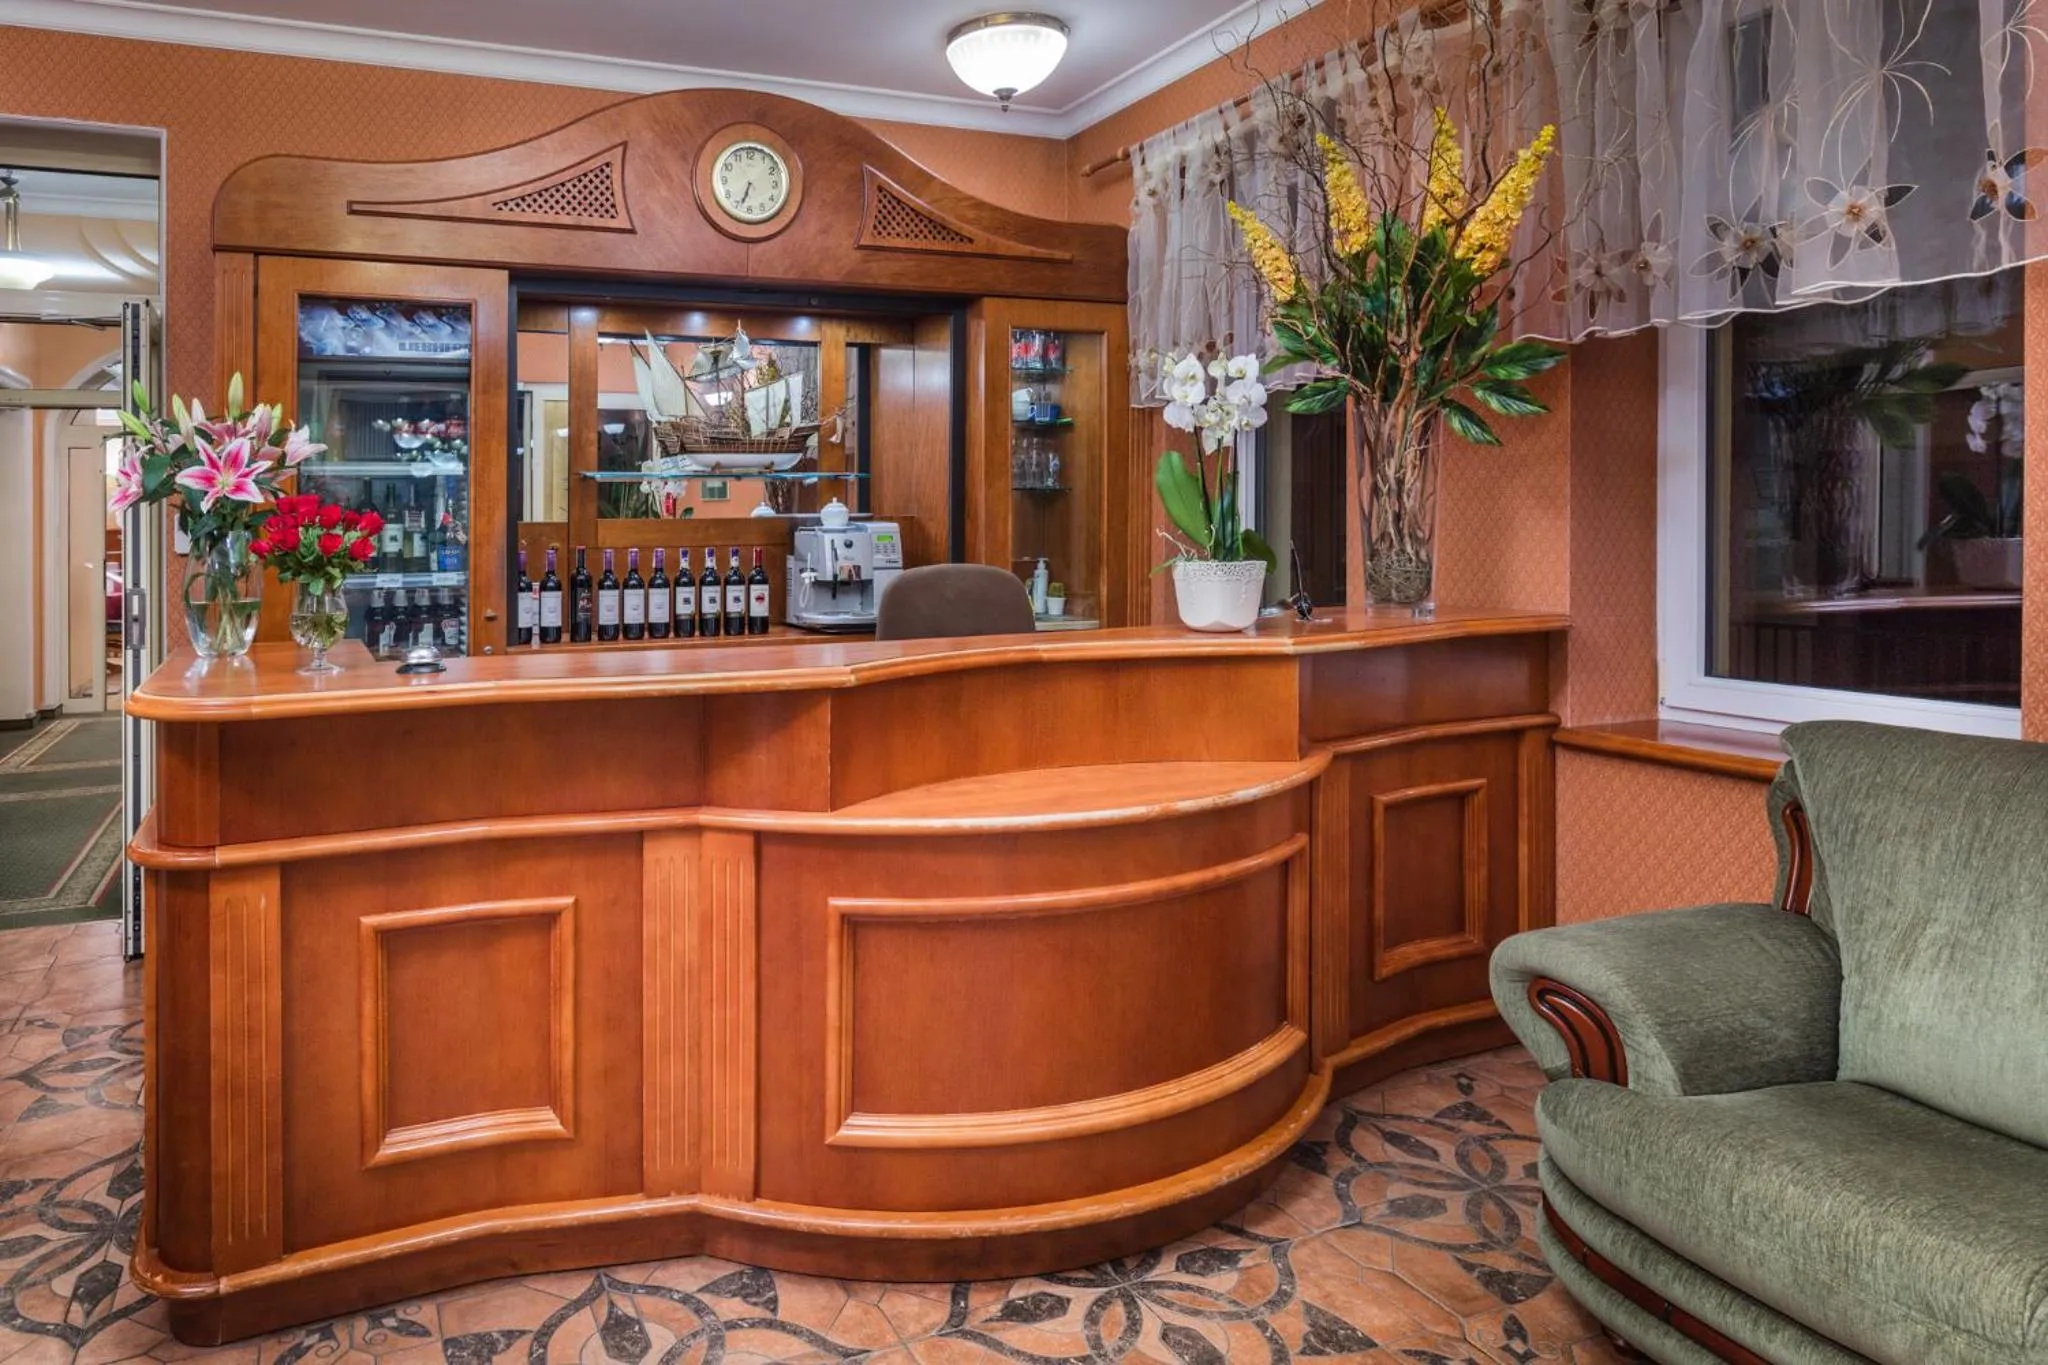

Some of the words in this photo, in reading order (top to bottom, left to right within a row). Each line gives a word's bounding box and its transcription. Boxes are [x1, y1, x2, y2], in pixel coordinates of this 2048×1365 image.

[734, 154, 741, 163] 11
[746, 150, 755, 160] 12
[724, 163, 733, 172] 10
[768, 166, 775, 176] 2
[721, 175, 728, 185] 9
[772, 180, 778, 189] 3
[768, 193, 774, 202] 4
[734, 200, 740, 209] 7
[759, 202, 765, 211] 5
[746, 205, 753, 214] 6
